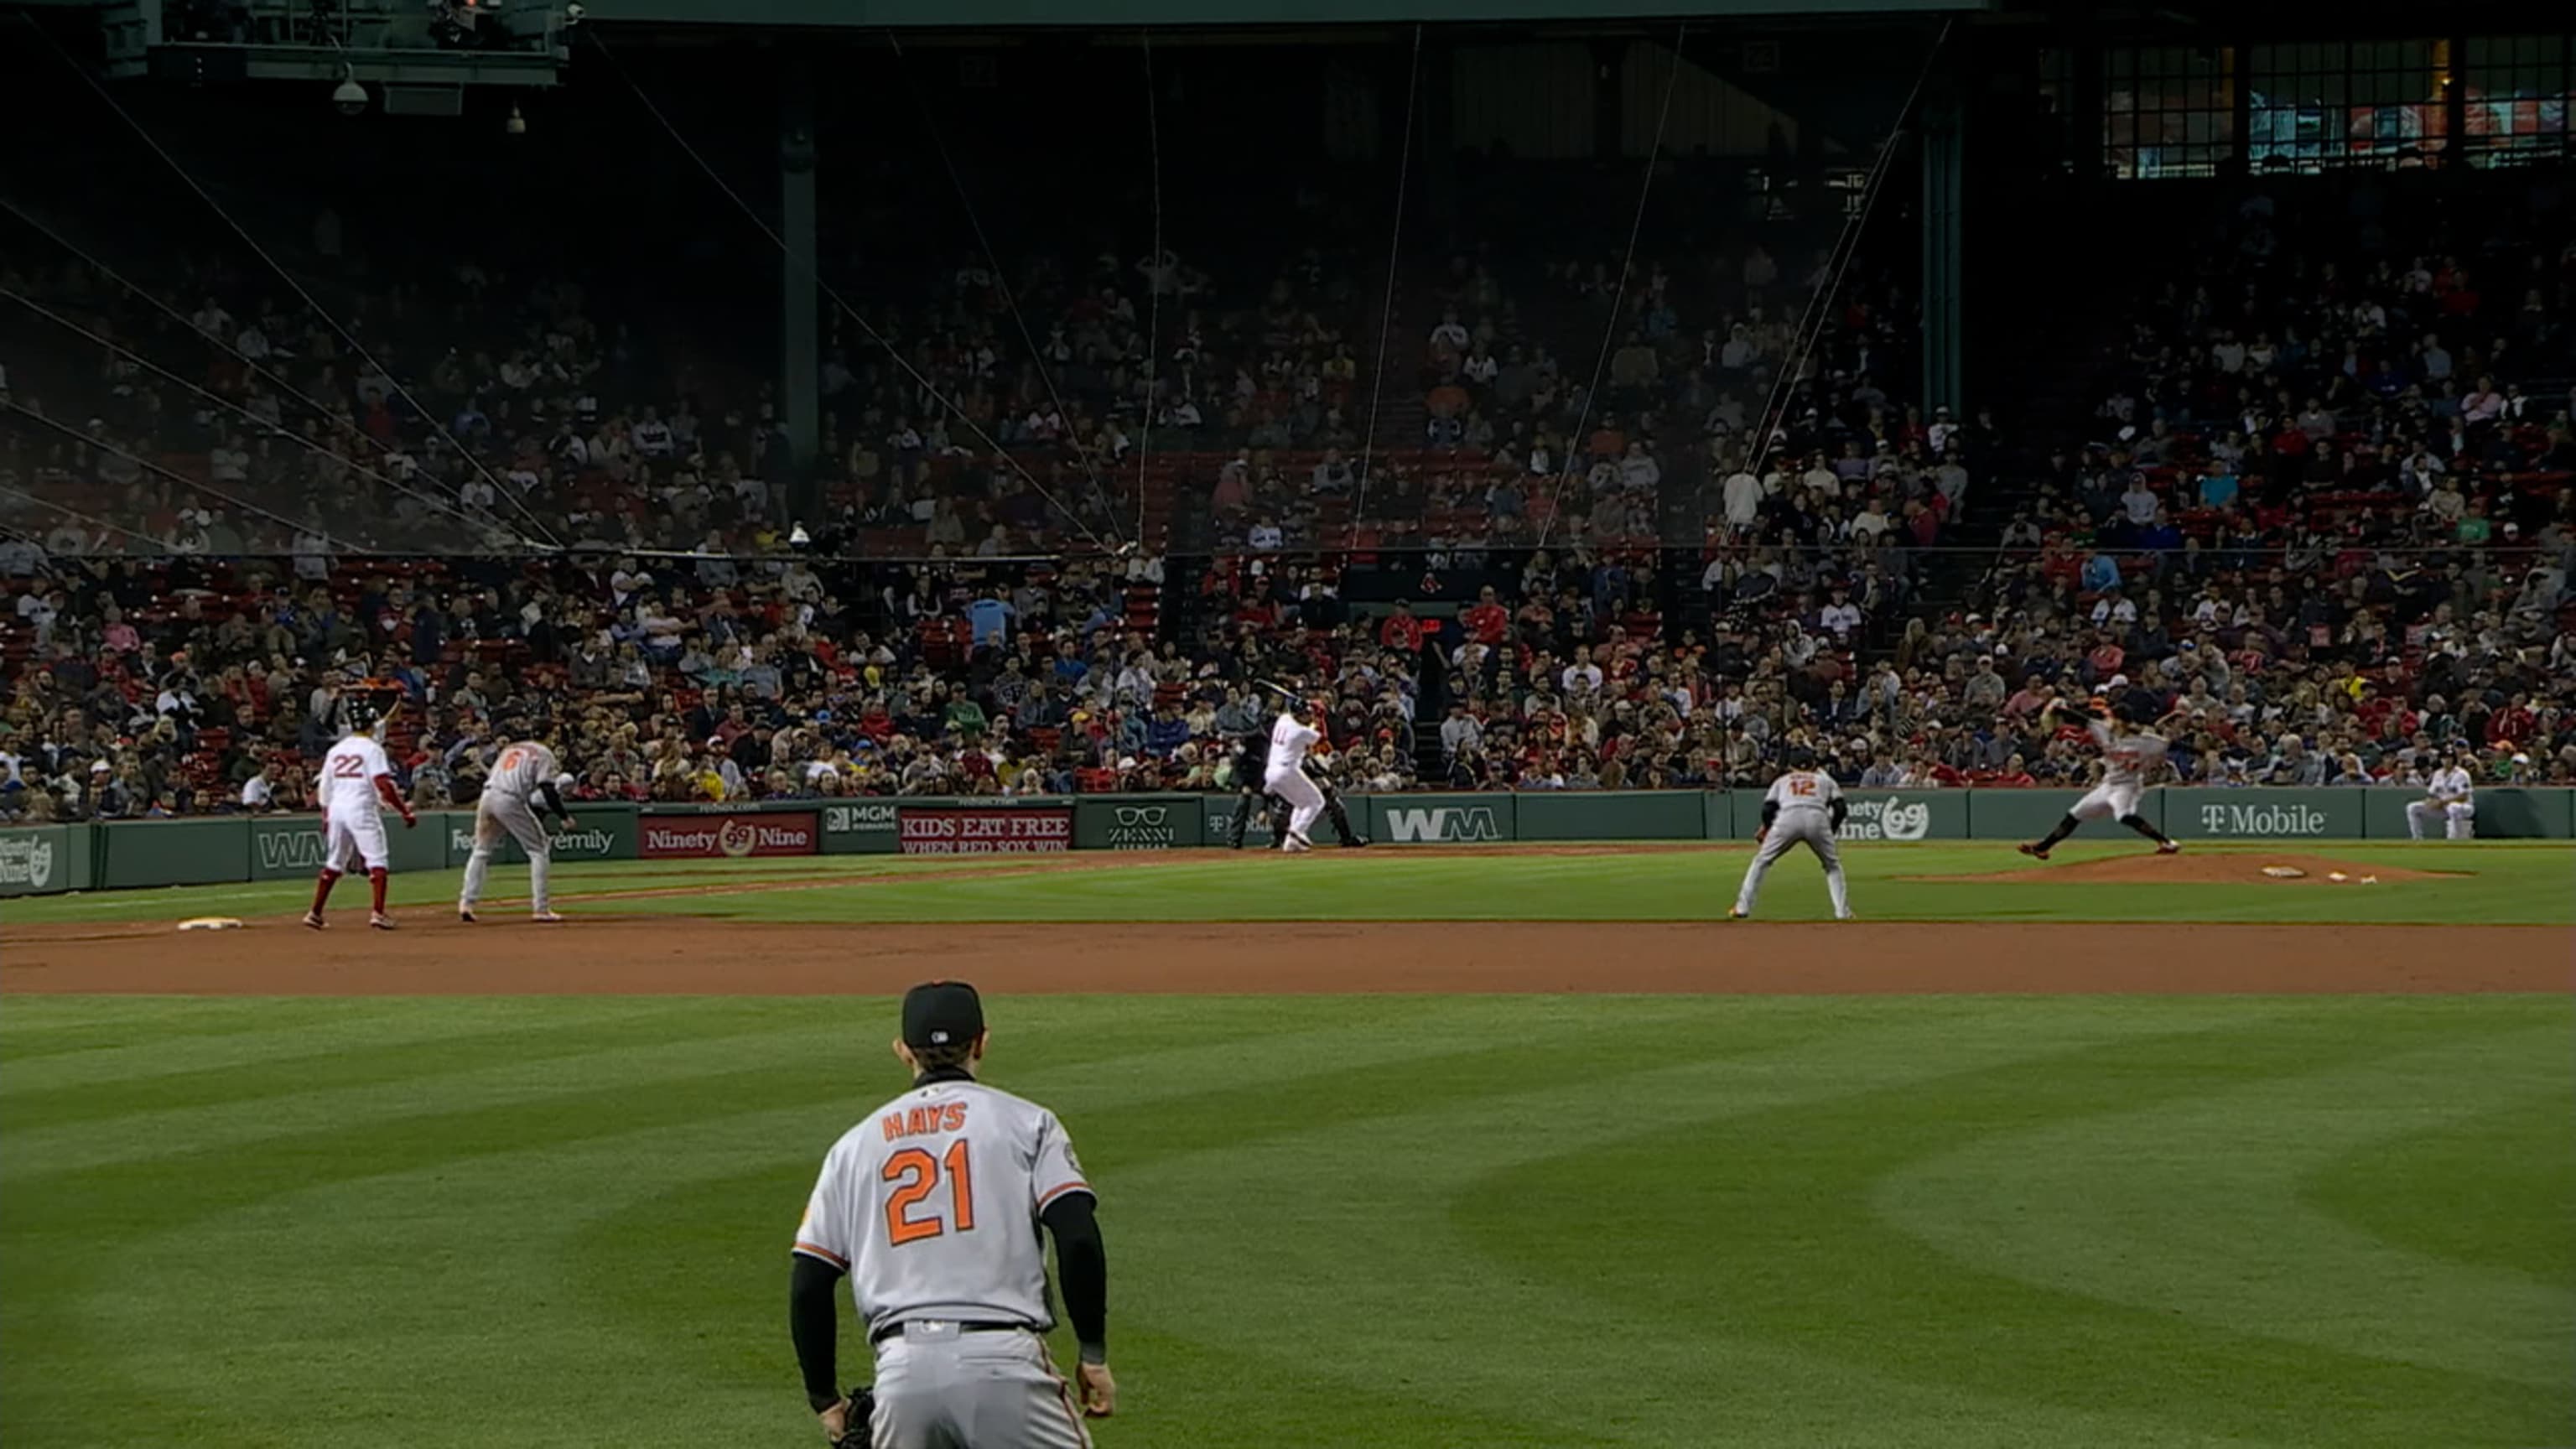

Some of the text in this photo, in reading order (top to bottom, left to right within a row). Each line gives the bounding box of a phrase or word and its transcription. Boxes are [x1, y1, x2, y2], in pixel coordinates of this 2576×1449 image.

[334, 755, 363, 778] 22
[1790, 781, 1817, 796] 12
[852, 806, 896, 821] MGM
[1386, 808, 1498, 840] WM
[2230, 804, 2324, 834] Mobile
[901, 816, 1069, 838] KIDS EAT FREE
[1109, 827, 1174, 841] ZENNI
[647, 829, 717, 851] Ninety
[759, 827, 808, 846] Nine
[902, 839, 1067, 854] WHEN RED SOX WIN
[882, 1102, 968, 1141] HAYS
[881, 1139, 974, 1247] 21
